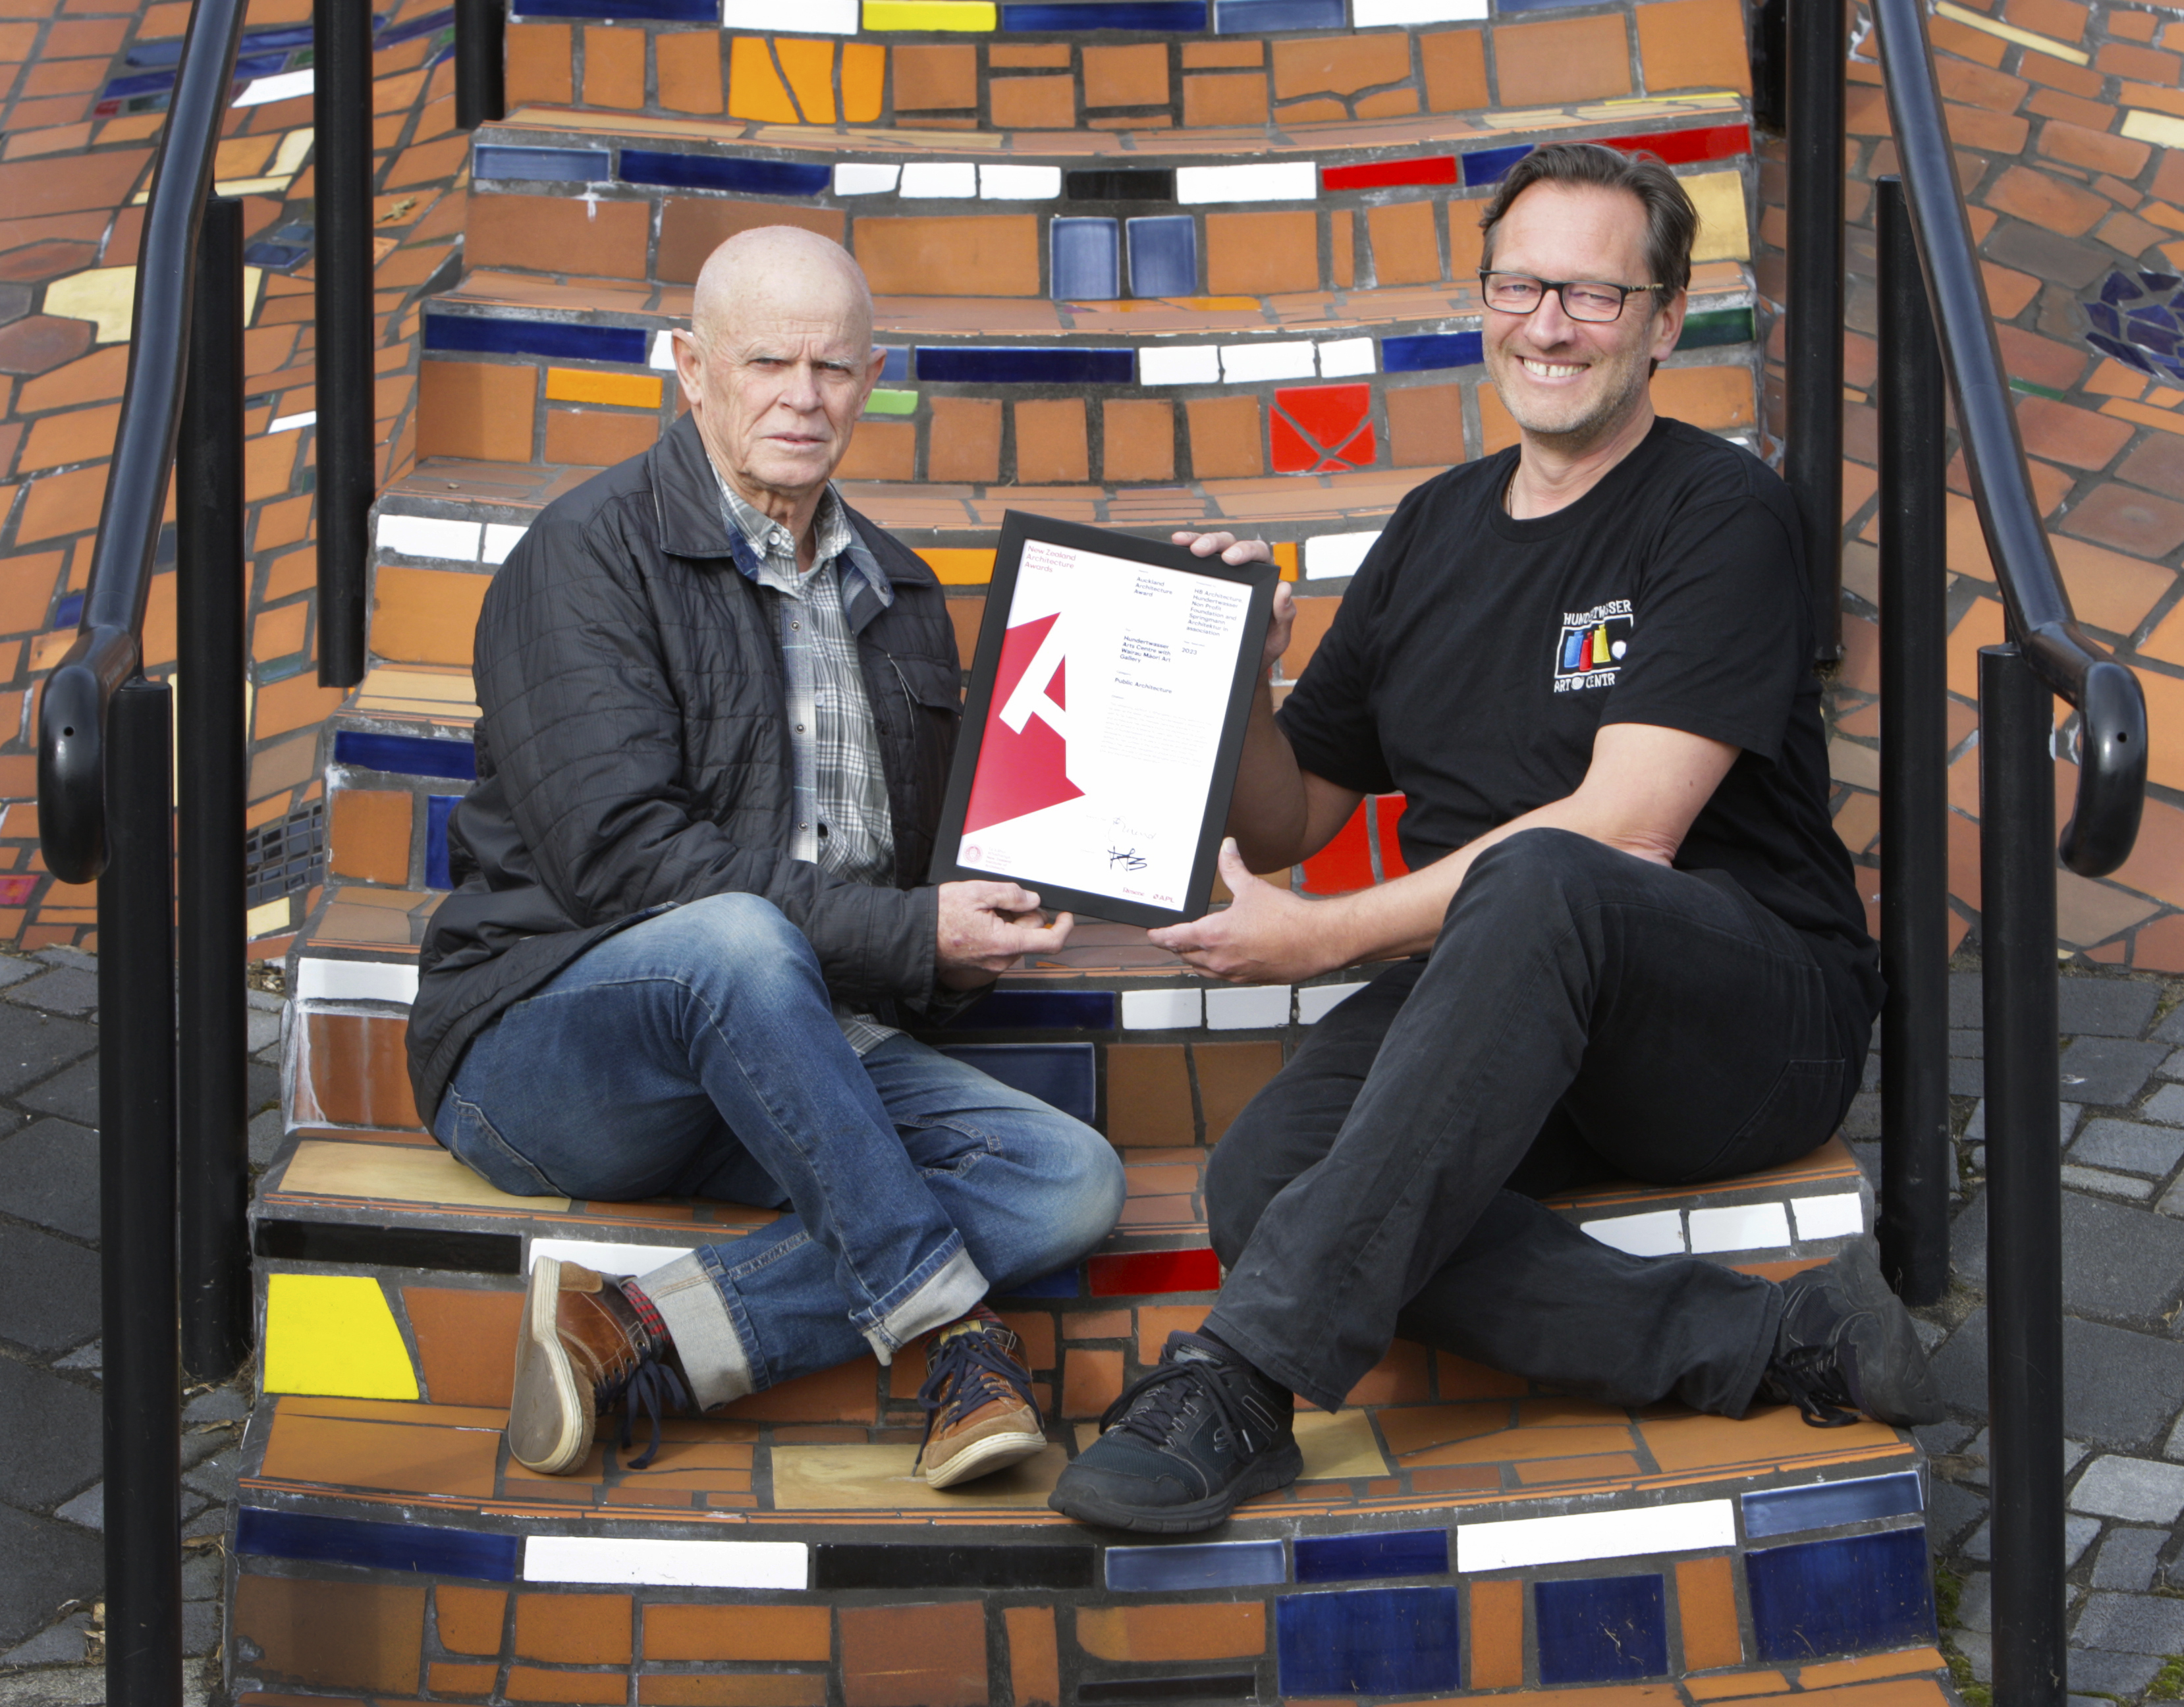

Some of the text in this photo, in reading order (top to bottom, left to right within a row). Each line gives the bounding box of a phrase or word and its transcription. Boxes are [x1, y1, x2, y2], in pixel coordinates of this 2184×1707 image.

[1028, 545, 1076, 561] New Zealand
[1025, 561, 1053, 573] Awards
[1026, 554, 1074, 568] Architecture
[1137, 576, 1164, 587] Auckland
[1135, 583, 1172, 595] Architecture
[1193, 595, 1238, 608] Hundertwasser
[1189, 612, 1226, 624] Springmann
[1190, 607, 1224, 618] Foundation
[1186, 626, 1220, 637] association
[1124, 636, 1169, 649] Hundertwasser
[1136, 644, 1157, 653] Centre
[1182, 647, 1198, 655] 2023
[1120, 654, 1141, 664] Gallery
[1114, 677, 1172, 693] Public Architecture
